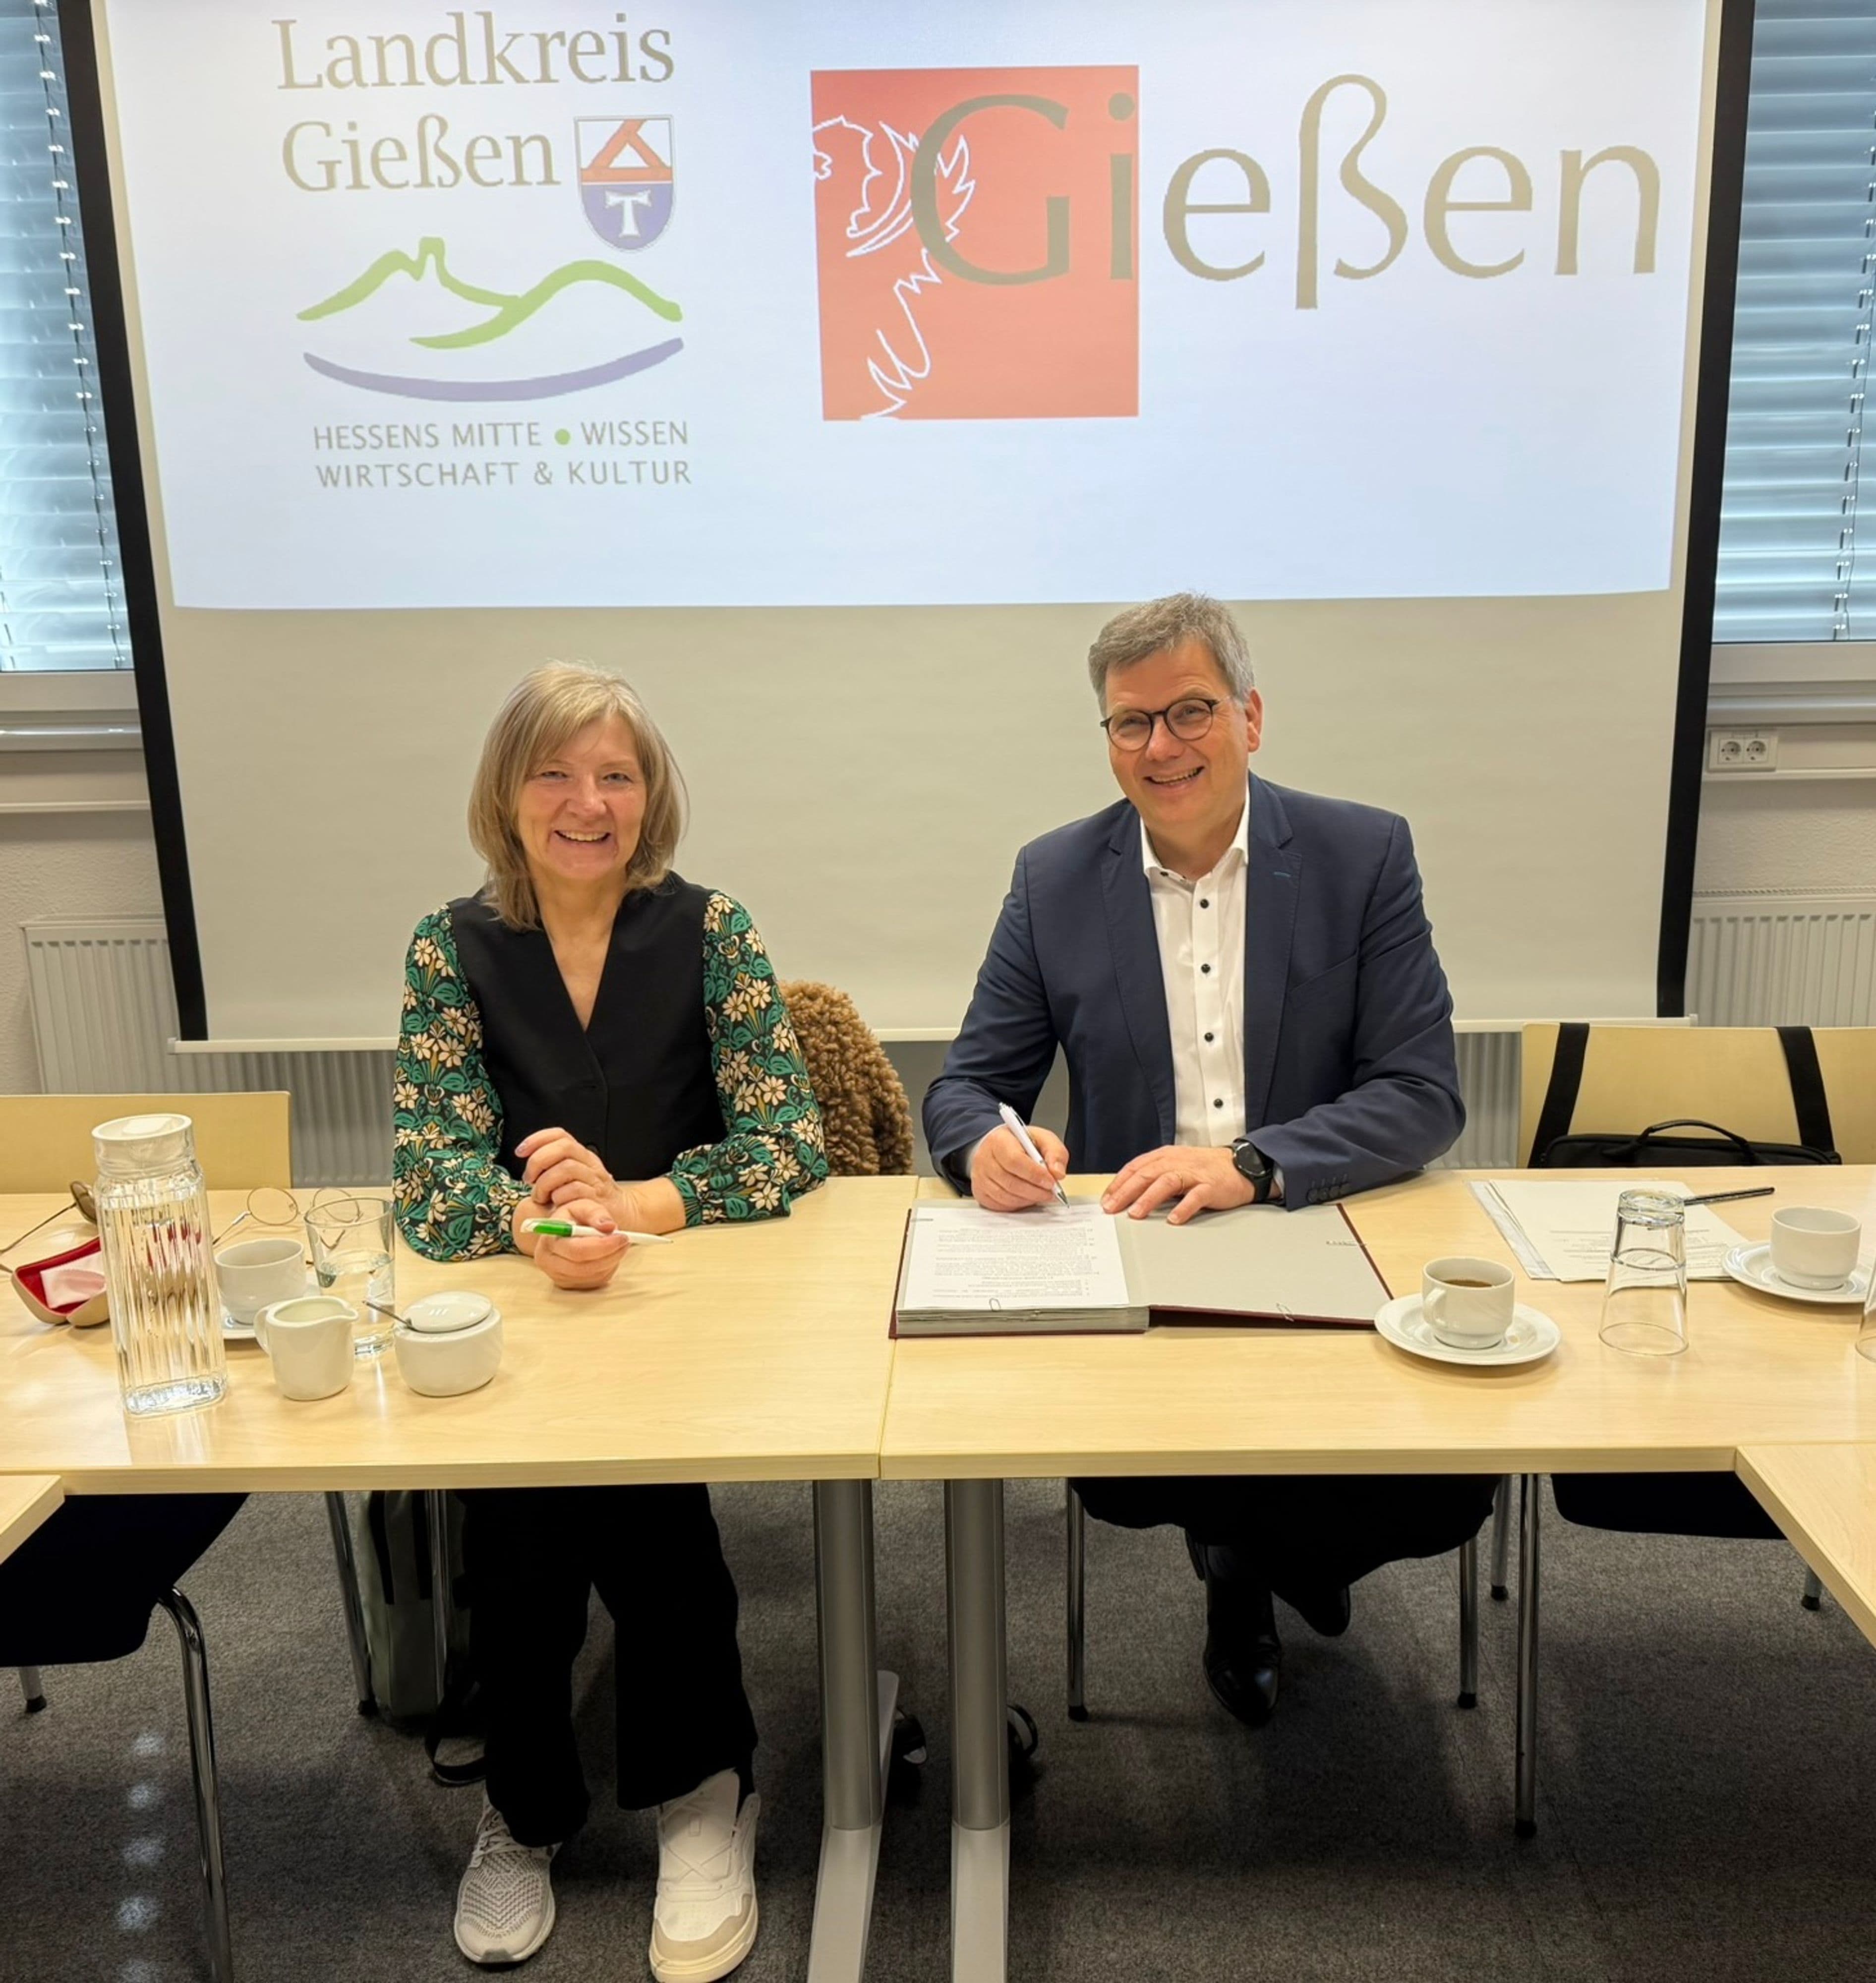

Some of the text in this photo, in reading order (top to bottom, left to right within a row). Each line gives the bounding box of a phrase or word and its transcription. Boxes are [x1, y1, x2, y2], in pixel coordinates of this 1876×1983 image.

[271, 10, 675, 90] Landkreis
[282, 114, 562, 192] Gießen
[909, 73, 1661, 310] Gießen
[313, 420, 689, 450] HESSENS MITTE WISSEN
[316, 461, 692, 488] WIRTSCHAFT & KULTUR
